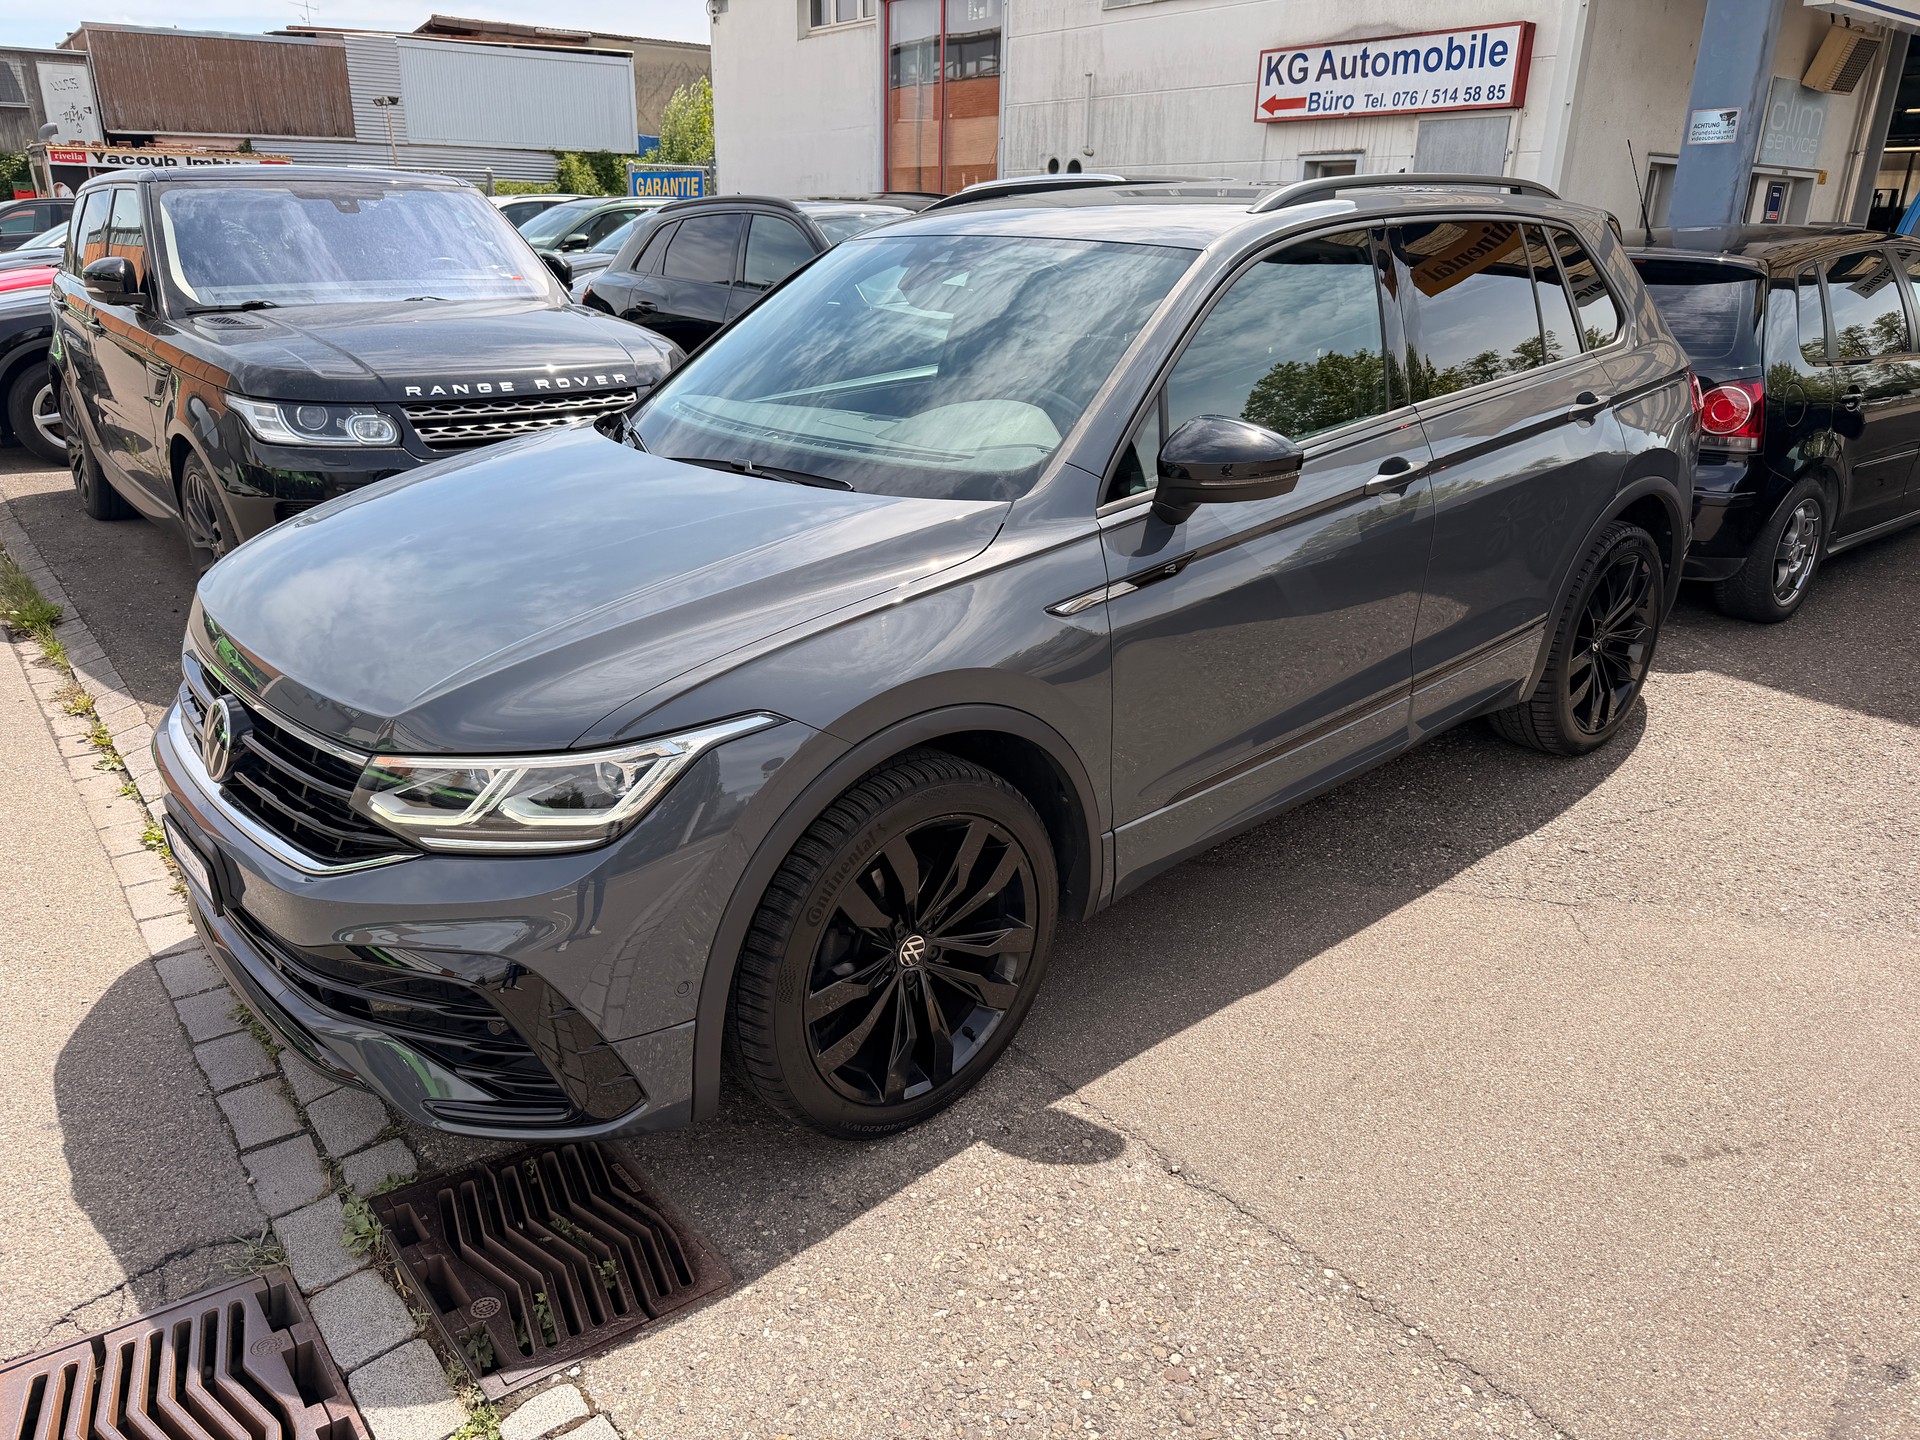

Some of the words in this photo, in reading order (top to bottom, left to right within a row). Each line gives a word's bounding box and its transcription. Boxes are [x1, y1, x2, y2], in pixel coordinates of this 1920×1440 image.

[1265, 53, 1309, 87] KG
[1315, 32, 1509, 83] Automobile
[1307, 90, 1355, 113] Büro
[1364, 93, 1387, 109] Tel.
[1392, 89, 1418, 107] 076
[1421, 89, 1428, 105] /
[1431, 87, 1459, 105] 514
[1463, 85, 1482, 103] 58
[1486, 84, 1506, 101] 85
[1693, 121, 1720, 129] ACHTUNG
[1770, 92, 1824, 136] clim
[1765, 133, 1818, 154] service
[54, 151, 84, 161] rivella
[92, 151, 177, 167] Yacoub
[636, 177, 699, 197] GARANTIE
[405, 381, 515, 397] RANGE
[534, 373, 628, 391] ROVER
[806, 831, 878, 927] Continental
